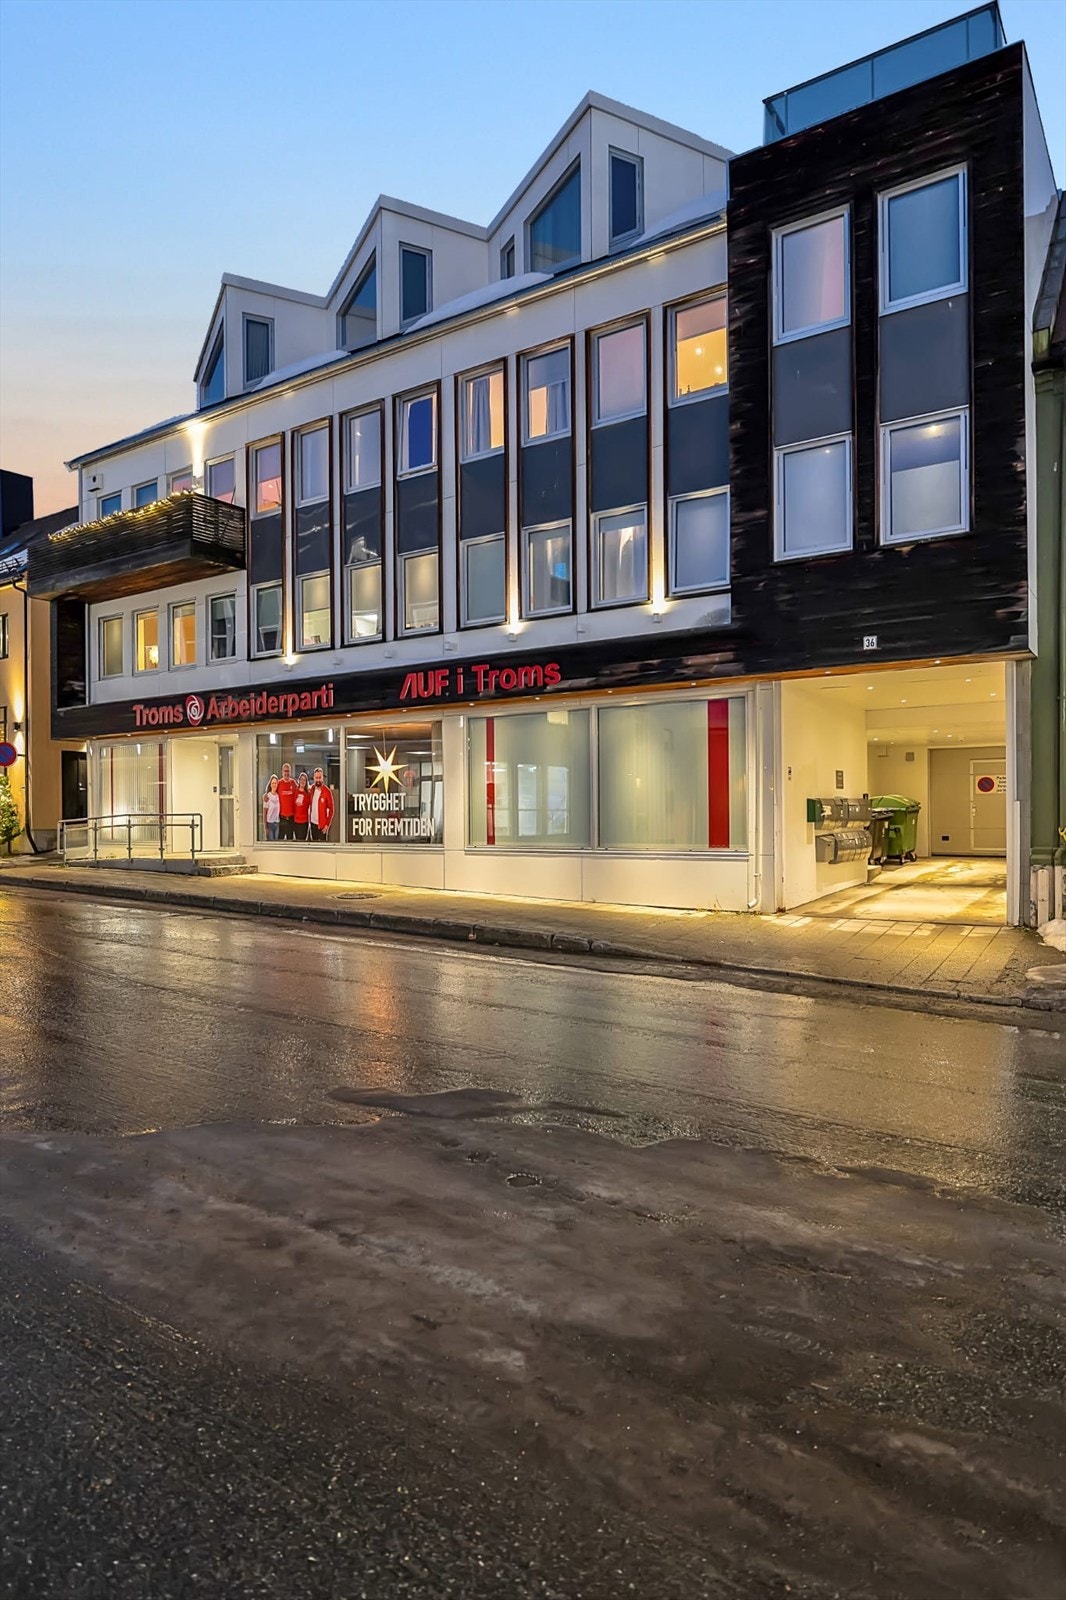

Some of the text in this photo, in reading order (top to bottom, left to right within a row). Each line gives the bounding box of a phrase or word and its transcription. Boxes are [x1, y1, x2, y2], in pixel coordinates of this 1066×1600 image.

[865, 638, 875, 648] 36
[400, 663, 562, 700] AUF i Troms
[132, 683, 334, 727] Troms Arbeiderparti
[352, 792, 406, 812] TRYGGHET
[352, 817, 435, 837] FOR FREMTIDEN
